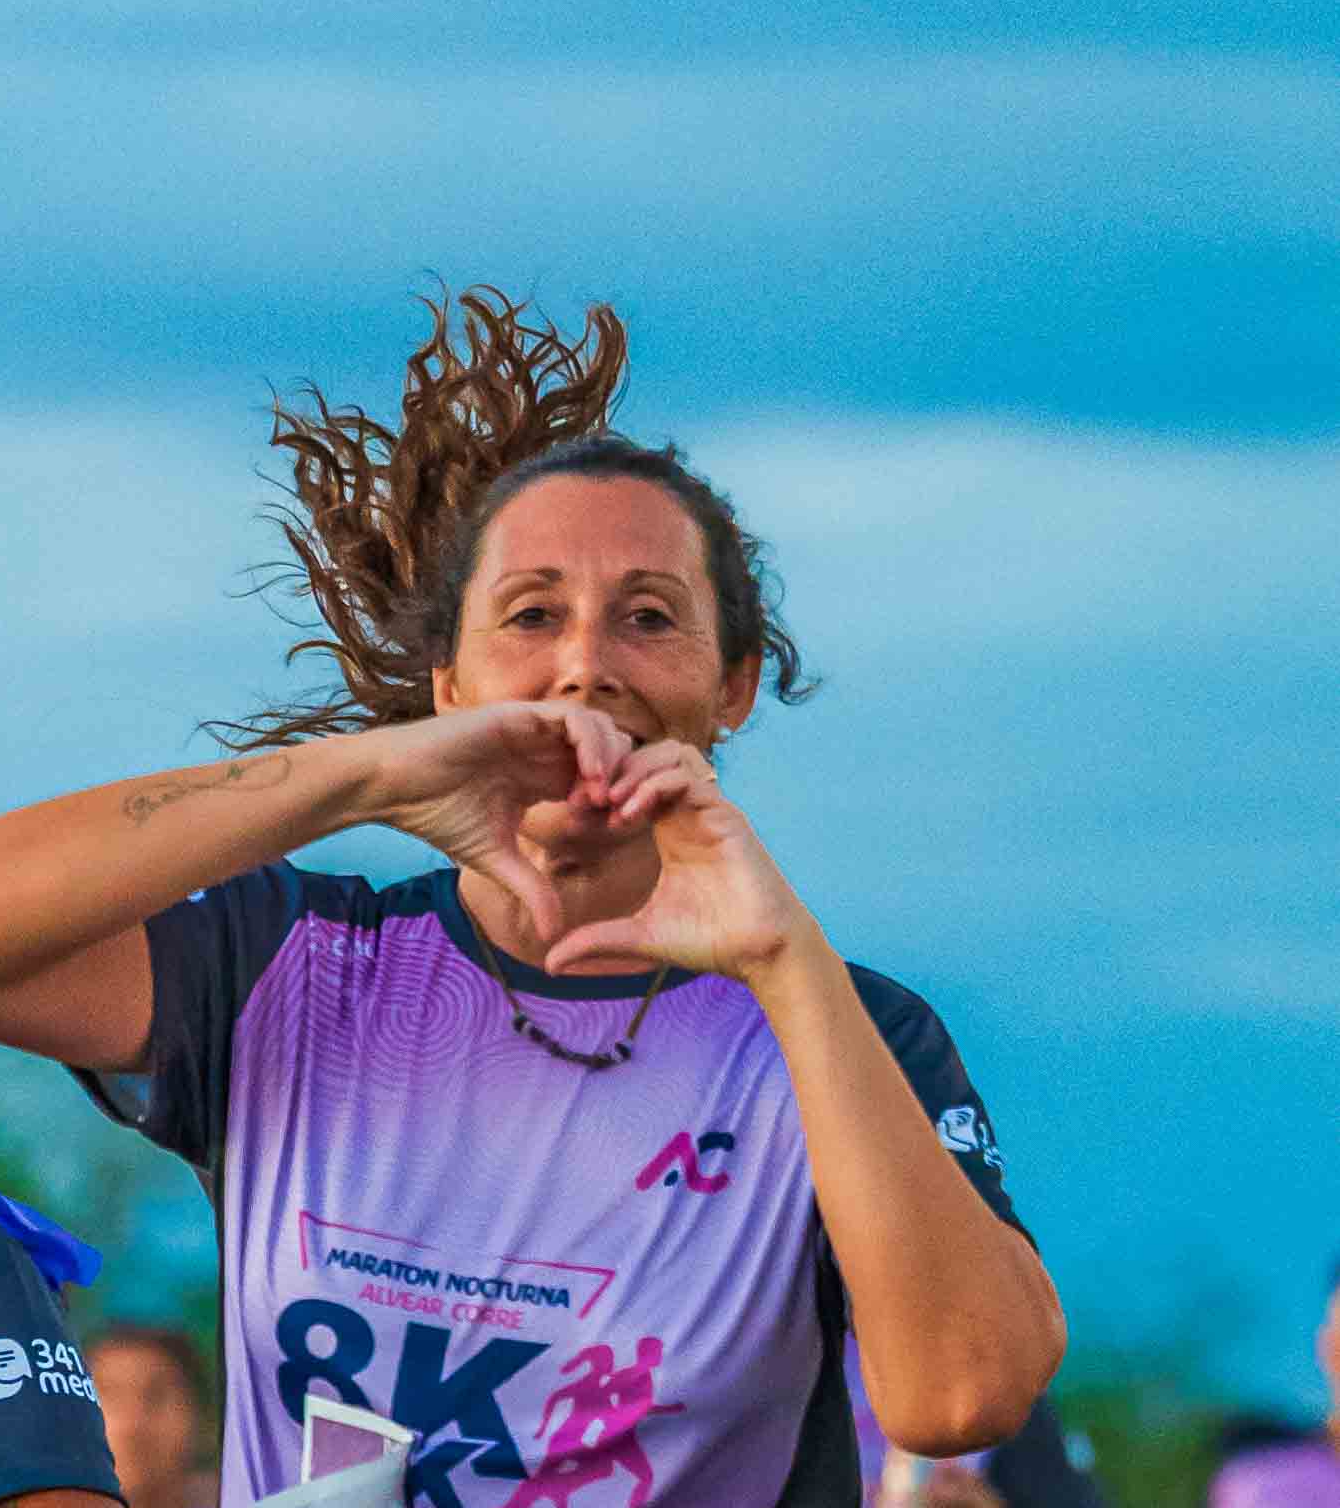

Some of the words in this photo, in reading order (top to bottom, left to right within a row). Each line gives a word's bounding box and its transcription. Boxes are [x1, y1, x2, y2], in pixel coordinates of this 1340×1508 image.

[327, 1249, 439, 1288] MARATON
[445, 1273, 569, 1309] NOCTURNA
[360, 1281, 443, 1316] ALVEAR
